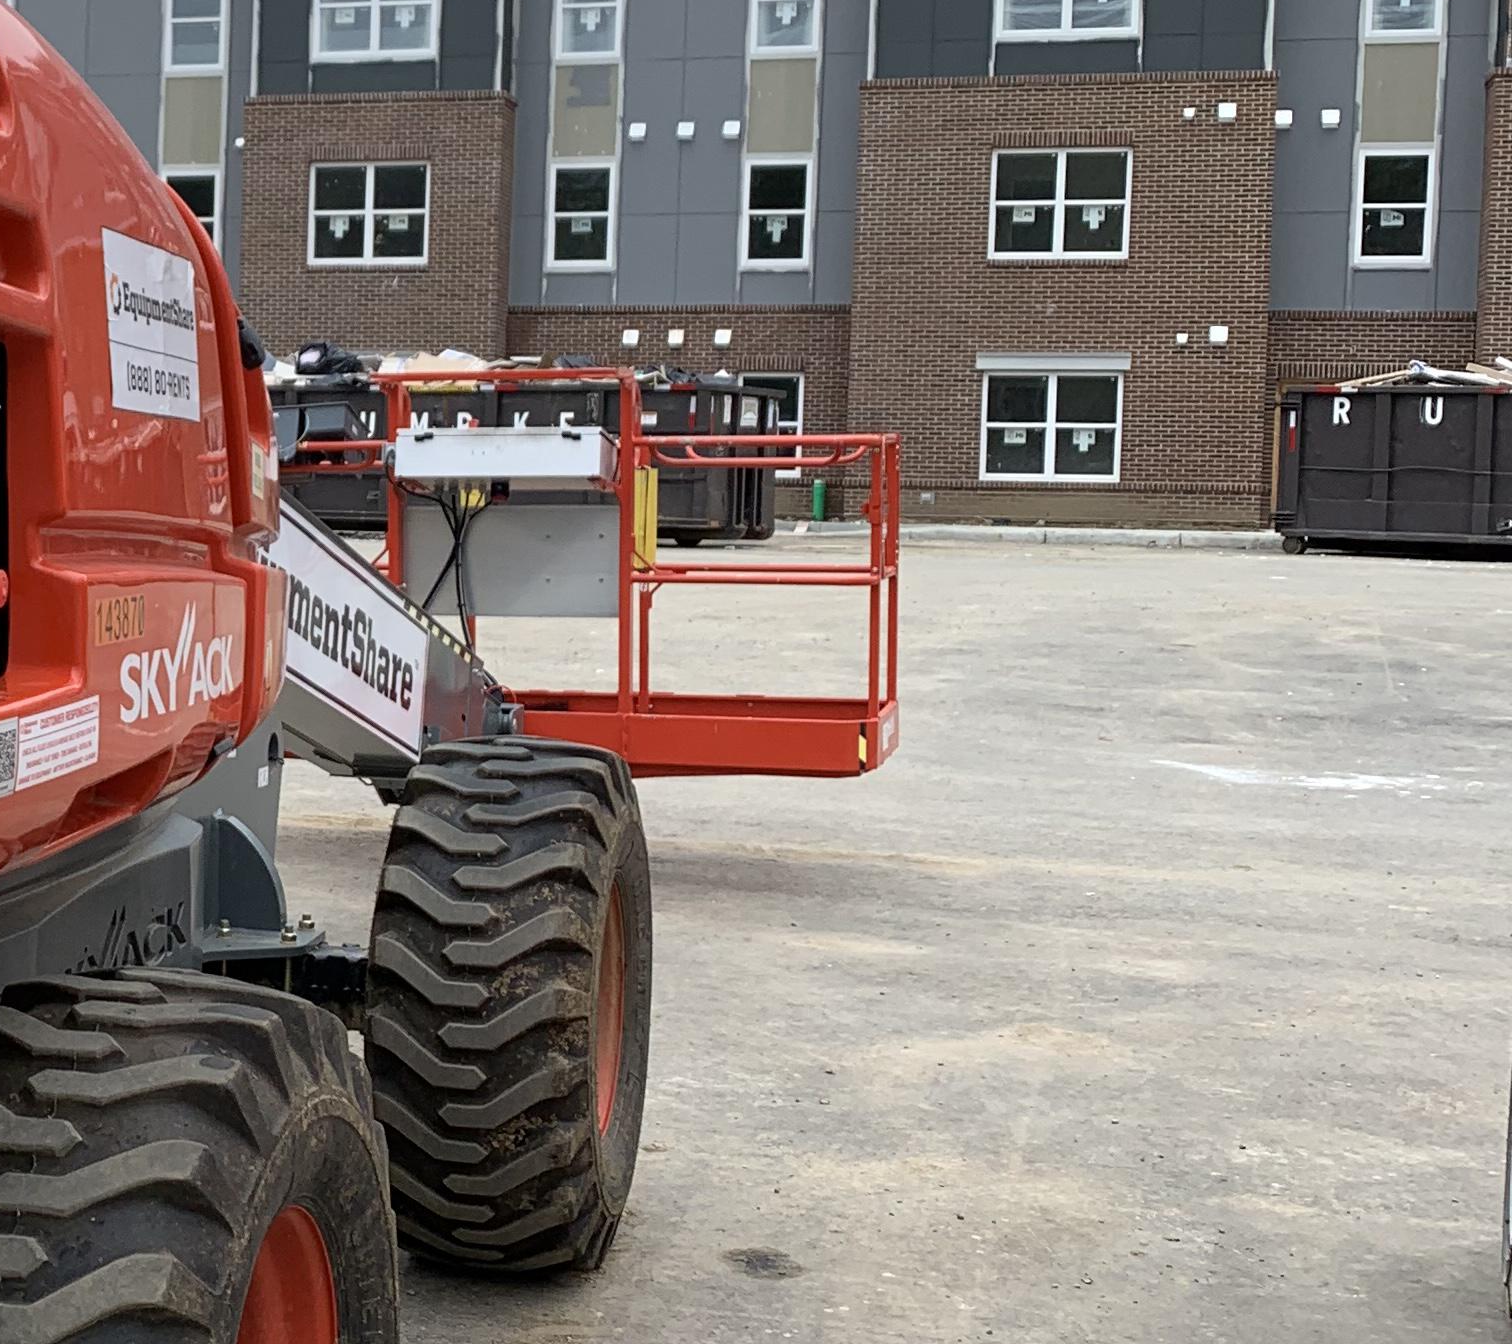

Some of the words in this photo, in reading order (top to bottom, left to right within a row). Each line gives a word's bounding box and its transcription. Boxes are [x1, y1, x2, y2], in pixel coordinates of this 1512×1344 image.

[122, 281, 194, 331] EquipmentShare
[127, 360, 152, 397] (888)
[96, 595, 145, 642] 143870
[265, 555, 414, 711] mentShare
